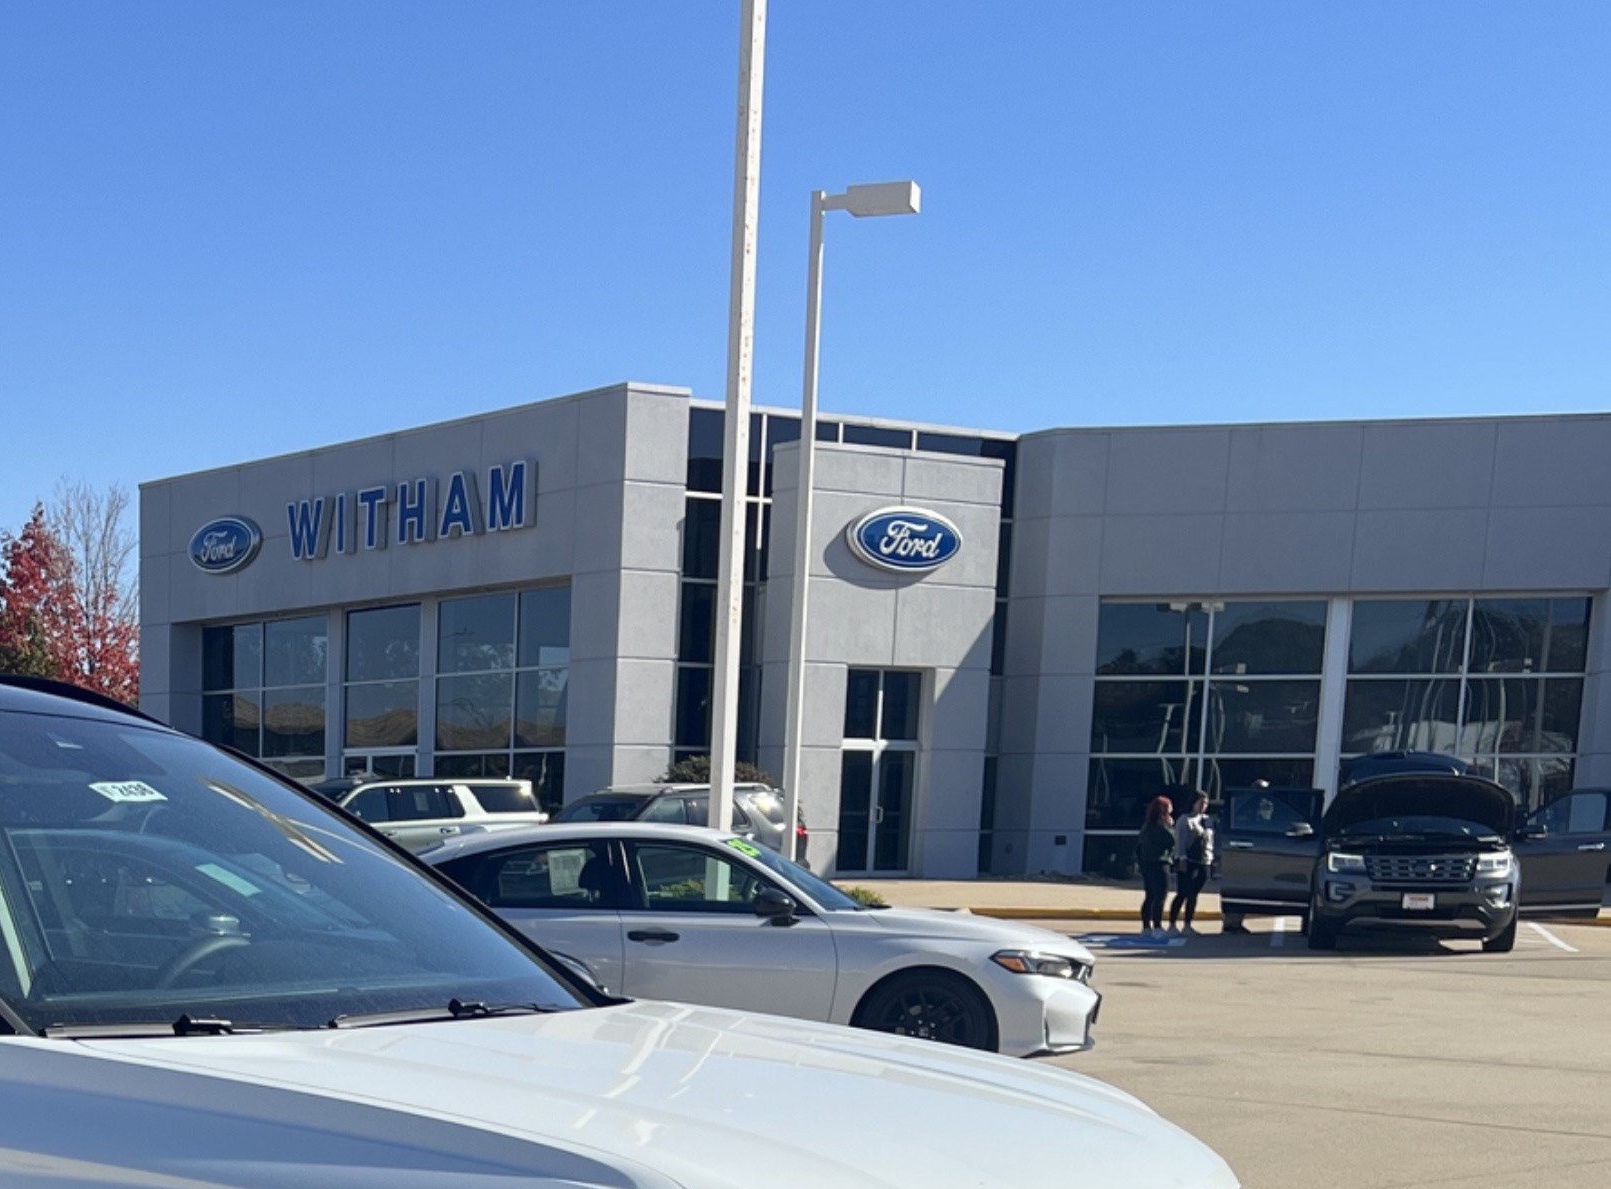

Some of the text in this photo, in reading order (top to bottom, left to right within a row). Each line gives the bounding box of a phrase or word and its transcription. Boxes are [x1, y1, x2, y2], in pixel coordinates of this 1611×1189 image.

[200, 459, 527, 563] Ford WITHAM
[879, 519, 944, 559] Ford
